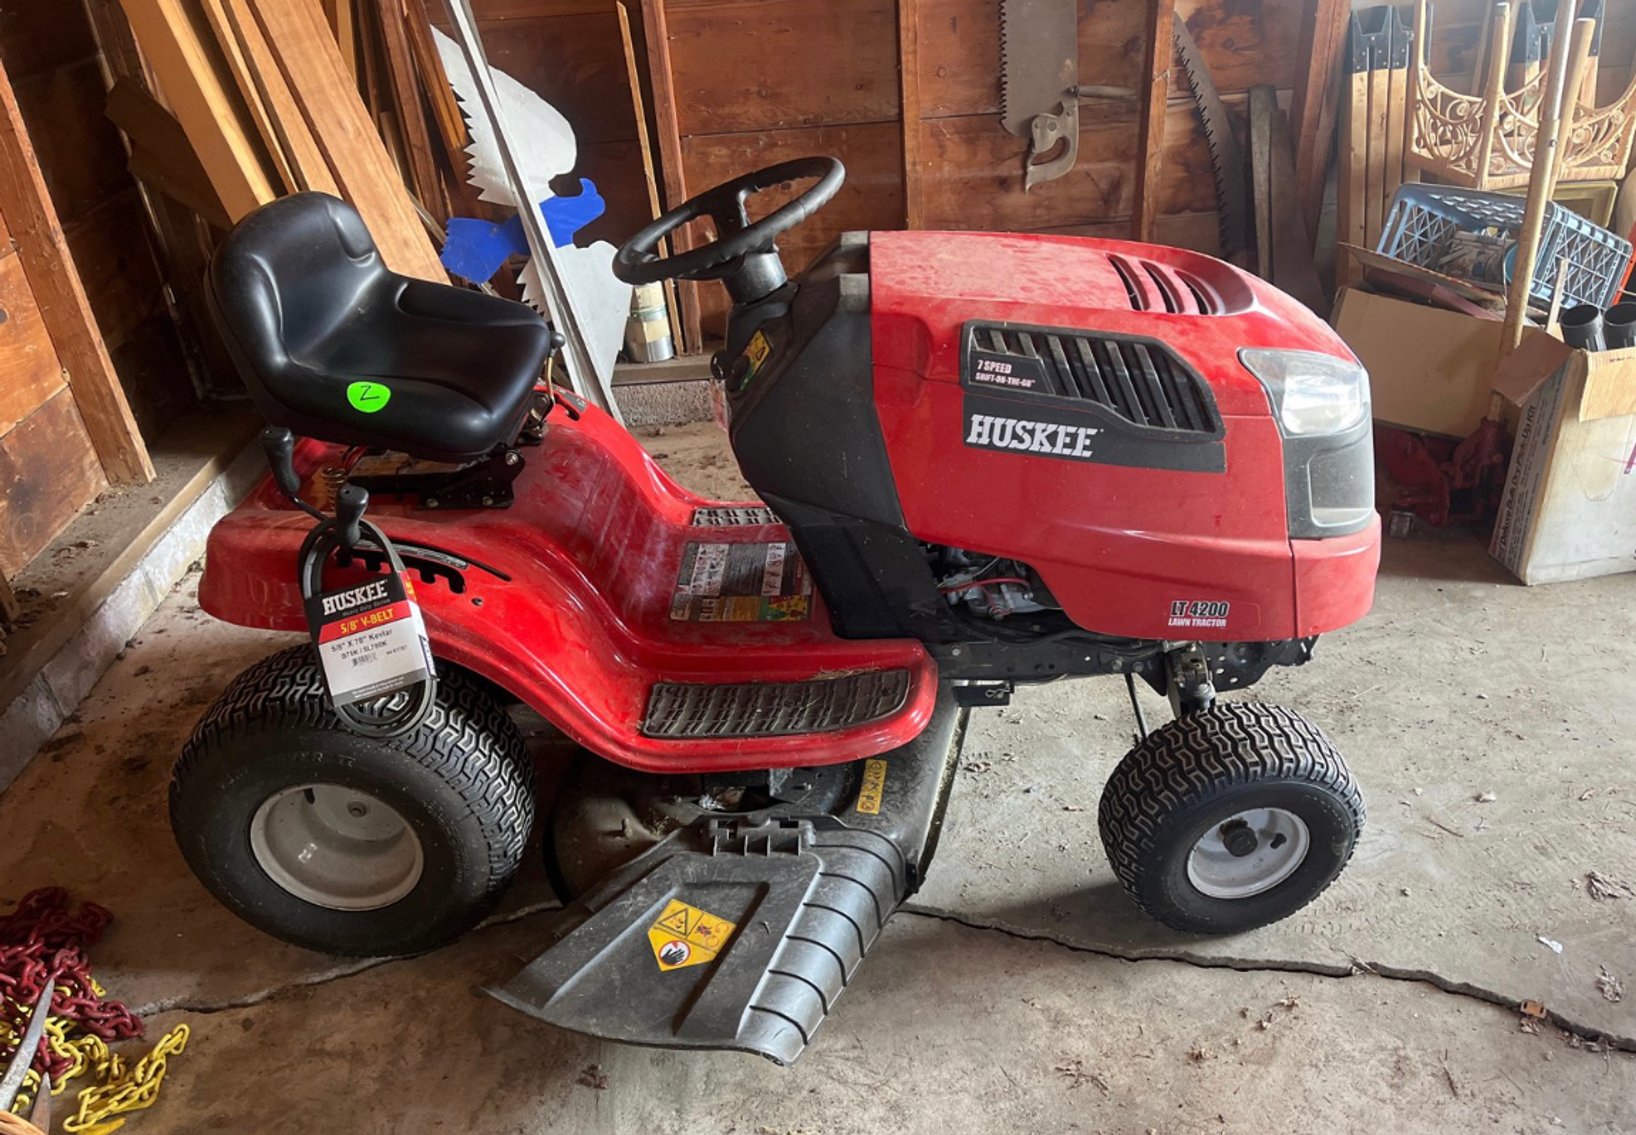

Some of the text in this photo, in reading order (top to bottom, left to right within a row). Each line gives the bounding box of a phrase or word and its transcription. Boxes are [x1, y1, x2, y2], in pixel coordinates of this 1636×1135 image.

[977, 360, 1012, 374] 7 SPEED
[966, 414, 1098, 458] HUSKEE
[322, 580, 388, 615] HUSKEE
[361, 608, 394, 626] V-BELT
[1171, 600, 1230, 618] LT 4200
[1168, 618, 1227, 627] LAWN TRACTOR
